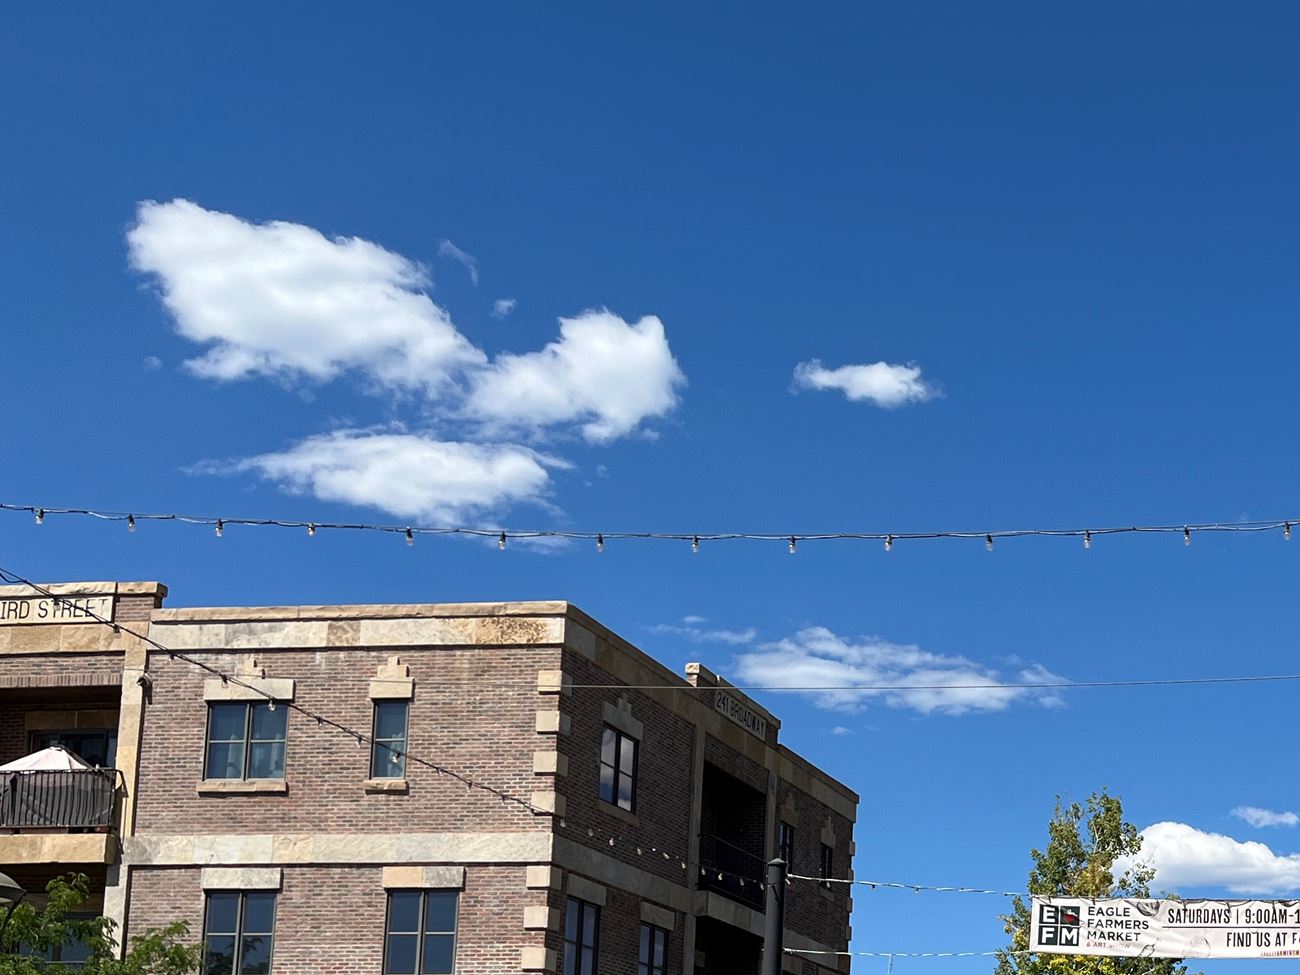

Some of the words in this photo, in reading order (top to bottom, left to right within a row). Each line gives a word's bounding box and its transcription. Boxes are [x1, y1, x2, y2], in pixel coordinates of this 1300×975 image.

[715, 692, 729, 713] 241
[730, 699, 765, 737] BROADWAY
[1087, 906, 1131, 917] EAGLE
[1167, 908, 1231, 924] SATURDAYS
[1087, 919, 1150, 930] FARMERS
[1086, 931, 1142, 942] MARKET
[1226, 932, 1252, 948] FIND
[1256, 931, 1271, 948] US
[1275, 932, 1288, 947] AT
